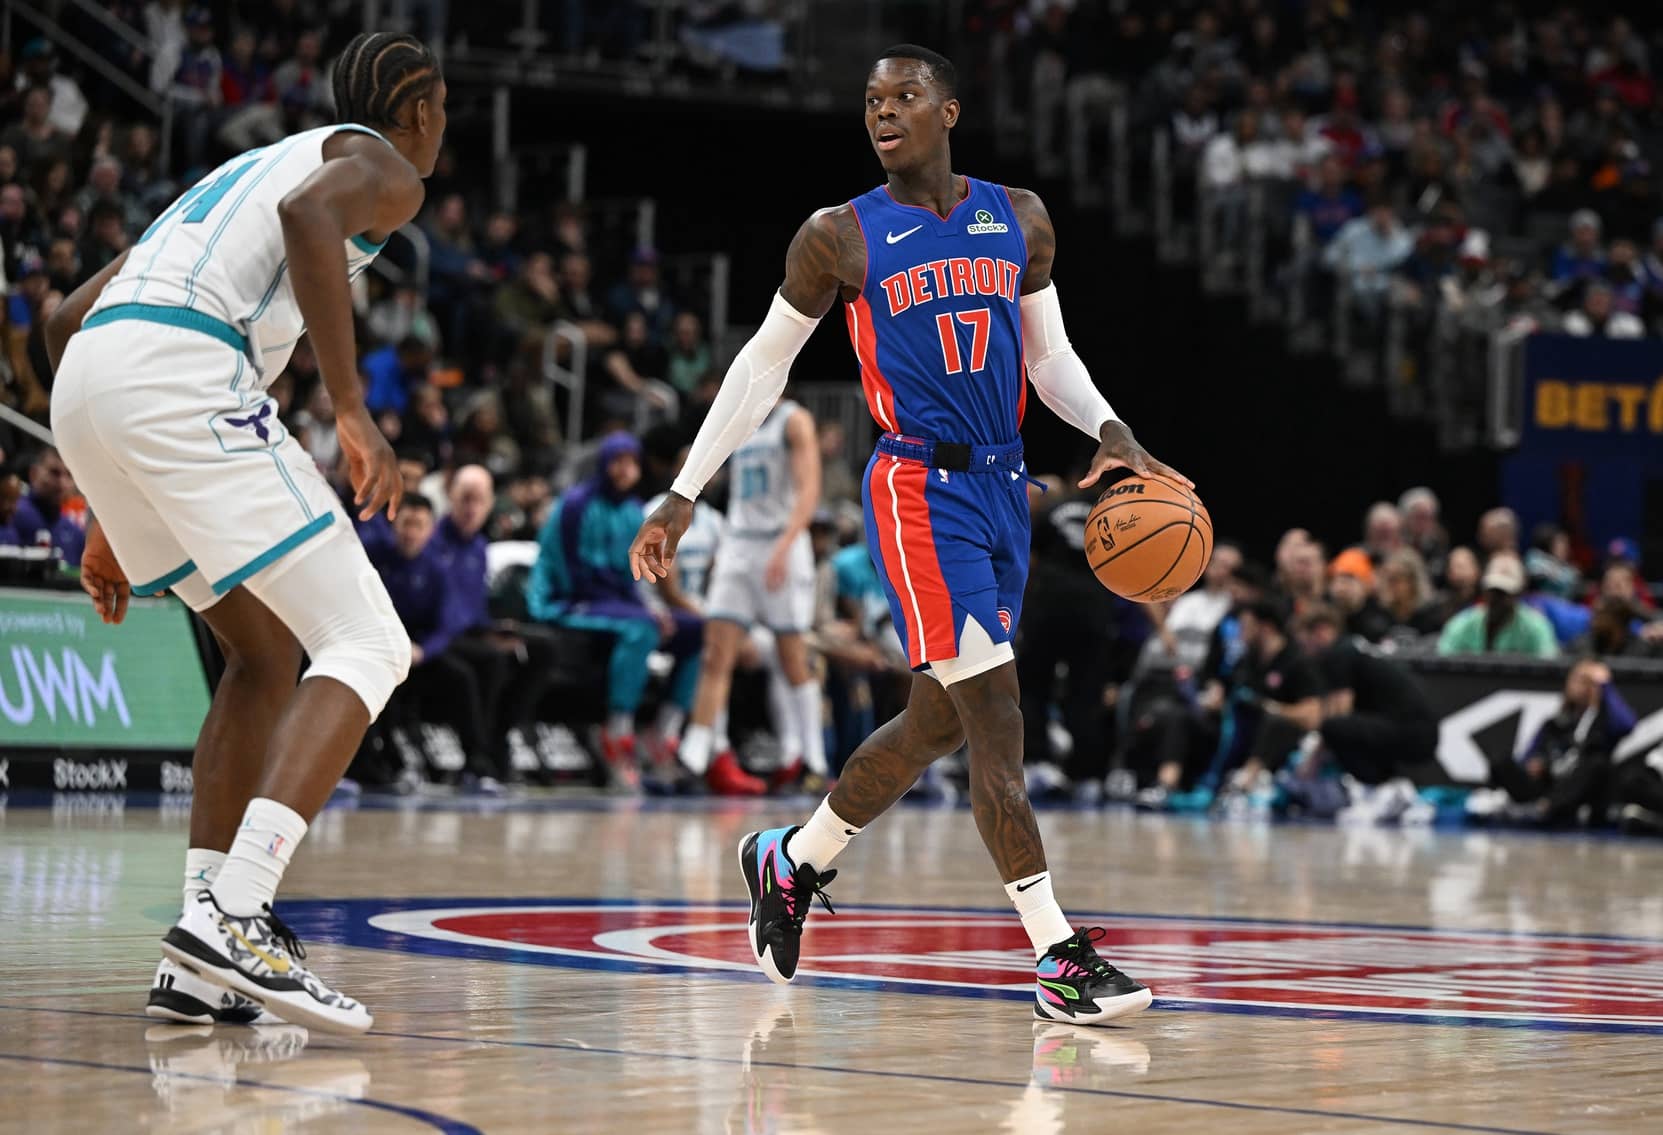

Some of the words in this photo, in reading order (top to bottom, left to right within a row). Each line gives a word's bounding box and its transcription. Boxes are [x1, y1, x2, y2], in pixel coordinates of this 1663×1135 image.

[969, 224, 1006, 233] StockX
[880, 257, 1020, 317] DETROIT
[936, 308, 991, 375] 17
[0, 645, 132, 728] UWM
[53, 757, 128, 790] StockX
